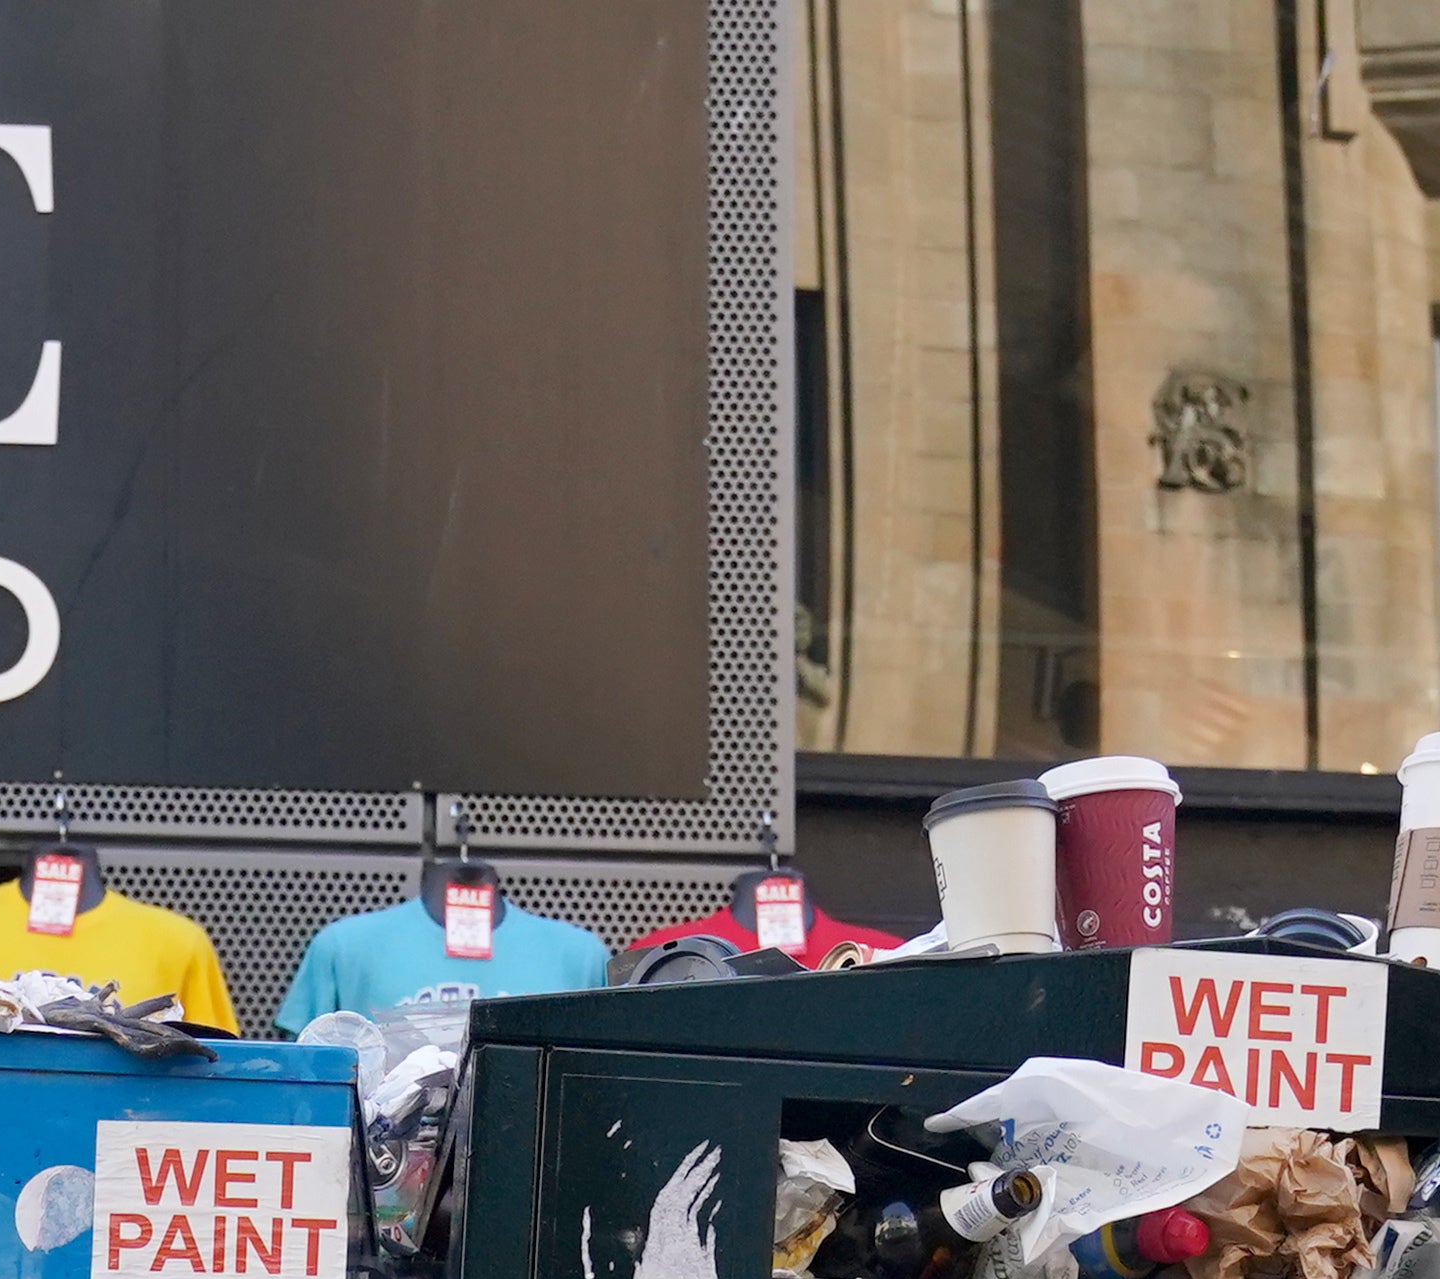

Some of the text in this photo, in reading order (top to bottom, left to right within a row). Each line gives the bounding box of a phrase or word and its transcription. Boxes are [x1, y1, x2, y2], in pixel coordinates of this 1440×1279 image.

[34, 855, 83, 881] SALE
[446, 884, 493, 909] SALE
[1142, 820, 1162, 928] COSTA
[1168, 975, 1348, 1043] WET
[1140, 1042, 1372, 1114] PAINT
[134, 1147, 312, 1210] WET
[107, 1213, 338, 1277] PAINT
